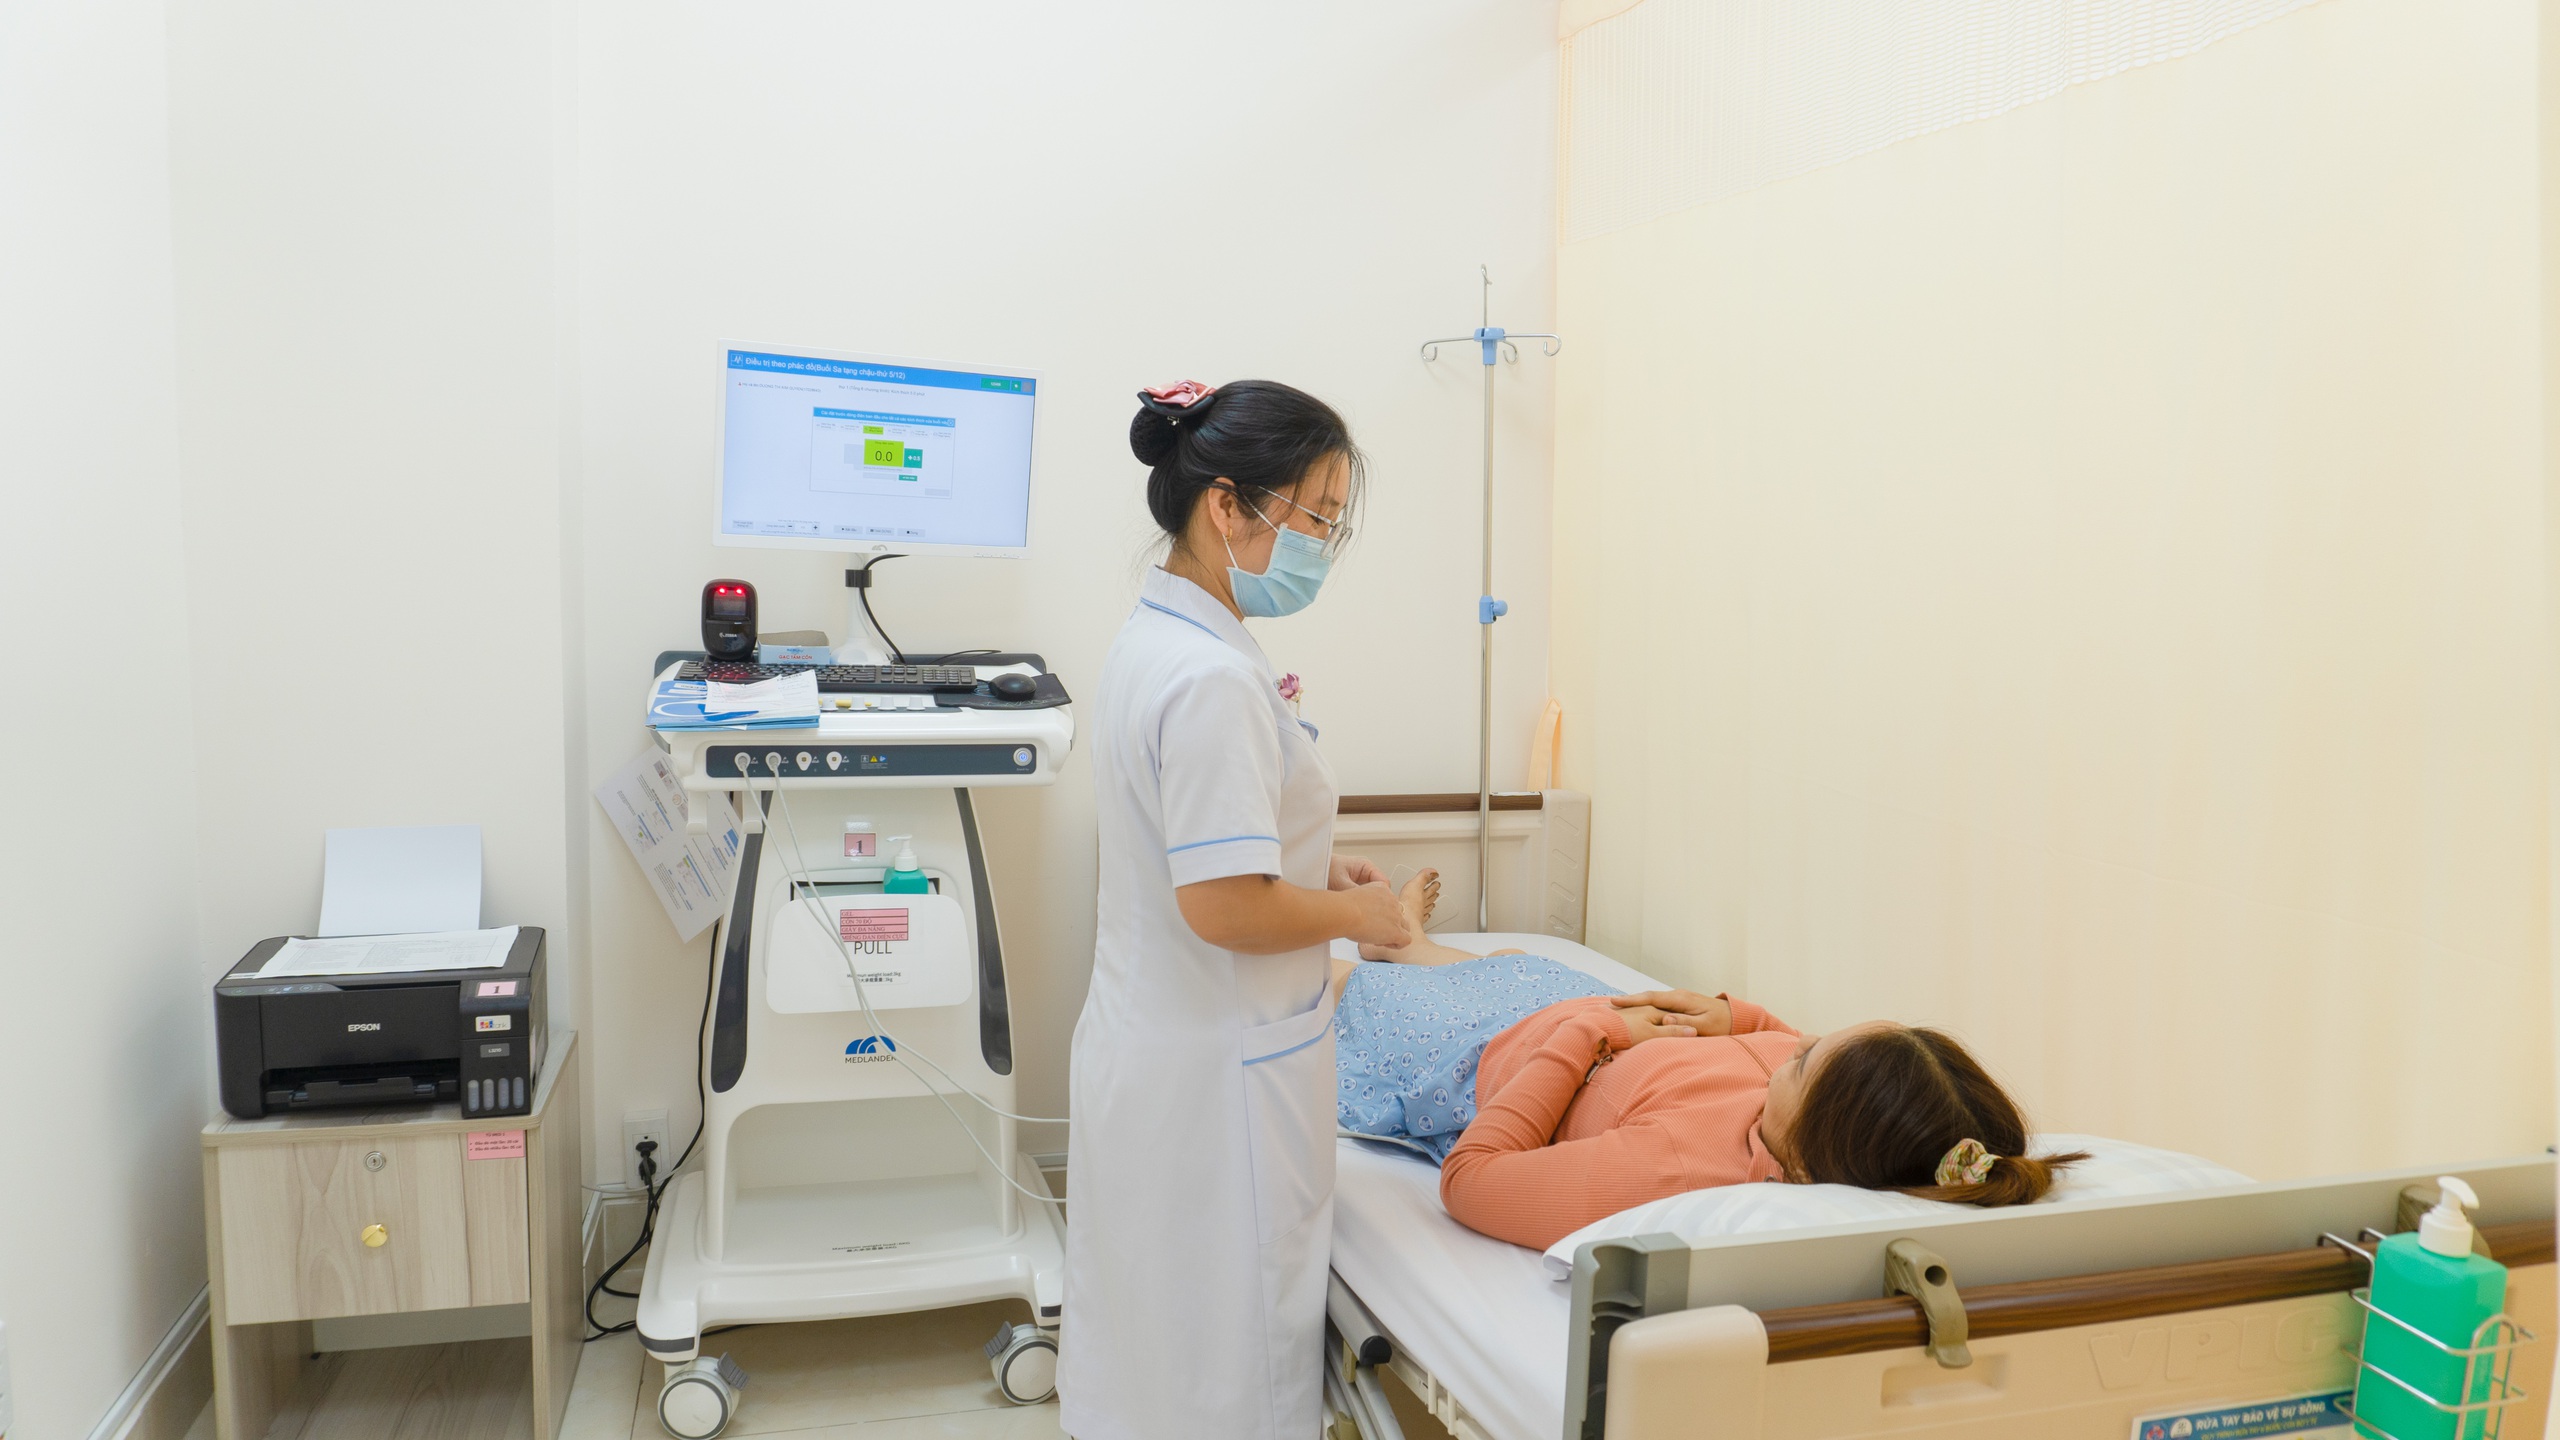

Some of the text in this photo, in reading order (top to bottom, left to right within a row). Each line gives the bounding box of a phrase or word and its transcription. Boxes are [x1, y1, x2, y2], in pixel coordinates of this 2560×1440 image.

[788, 361, 804, 370] phác
[889, 371, 906, 380] 5/12)
[875, 450, 892, 462] 0.0
[856, 840, 863, 854] 1
[854, 941, 892, 954] PULL
[494, 986, 500, 994] 1
[348, 1022, 381, 1032] EPSON
[2196, 1416, 2219, 1431] RỬA
[2221, 1414, 2240, 1427] TAY
[2243, 1408, 2264, 1424] BẢO
